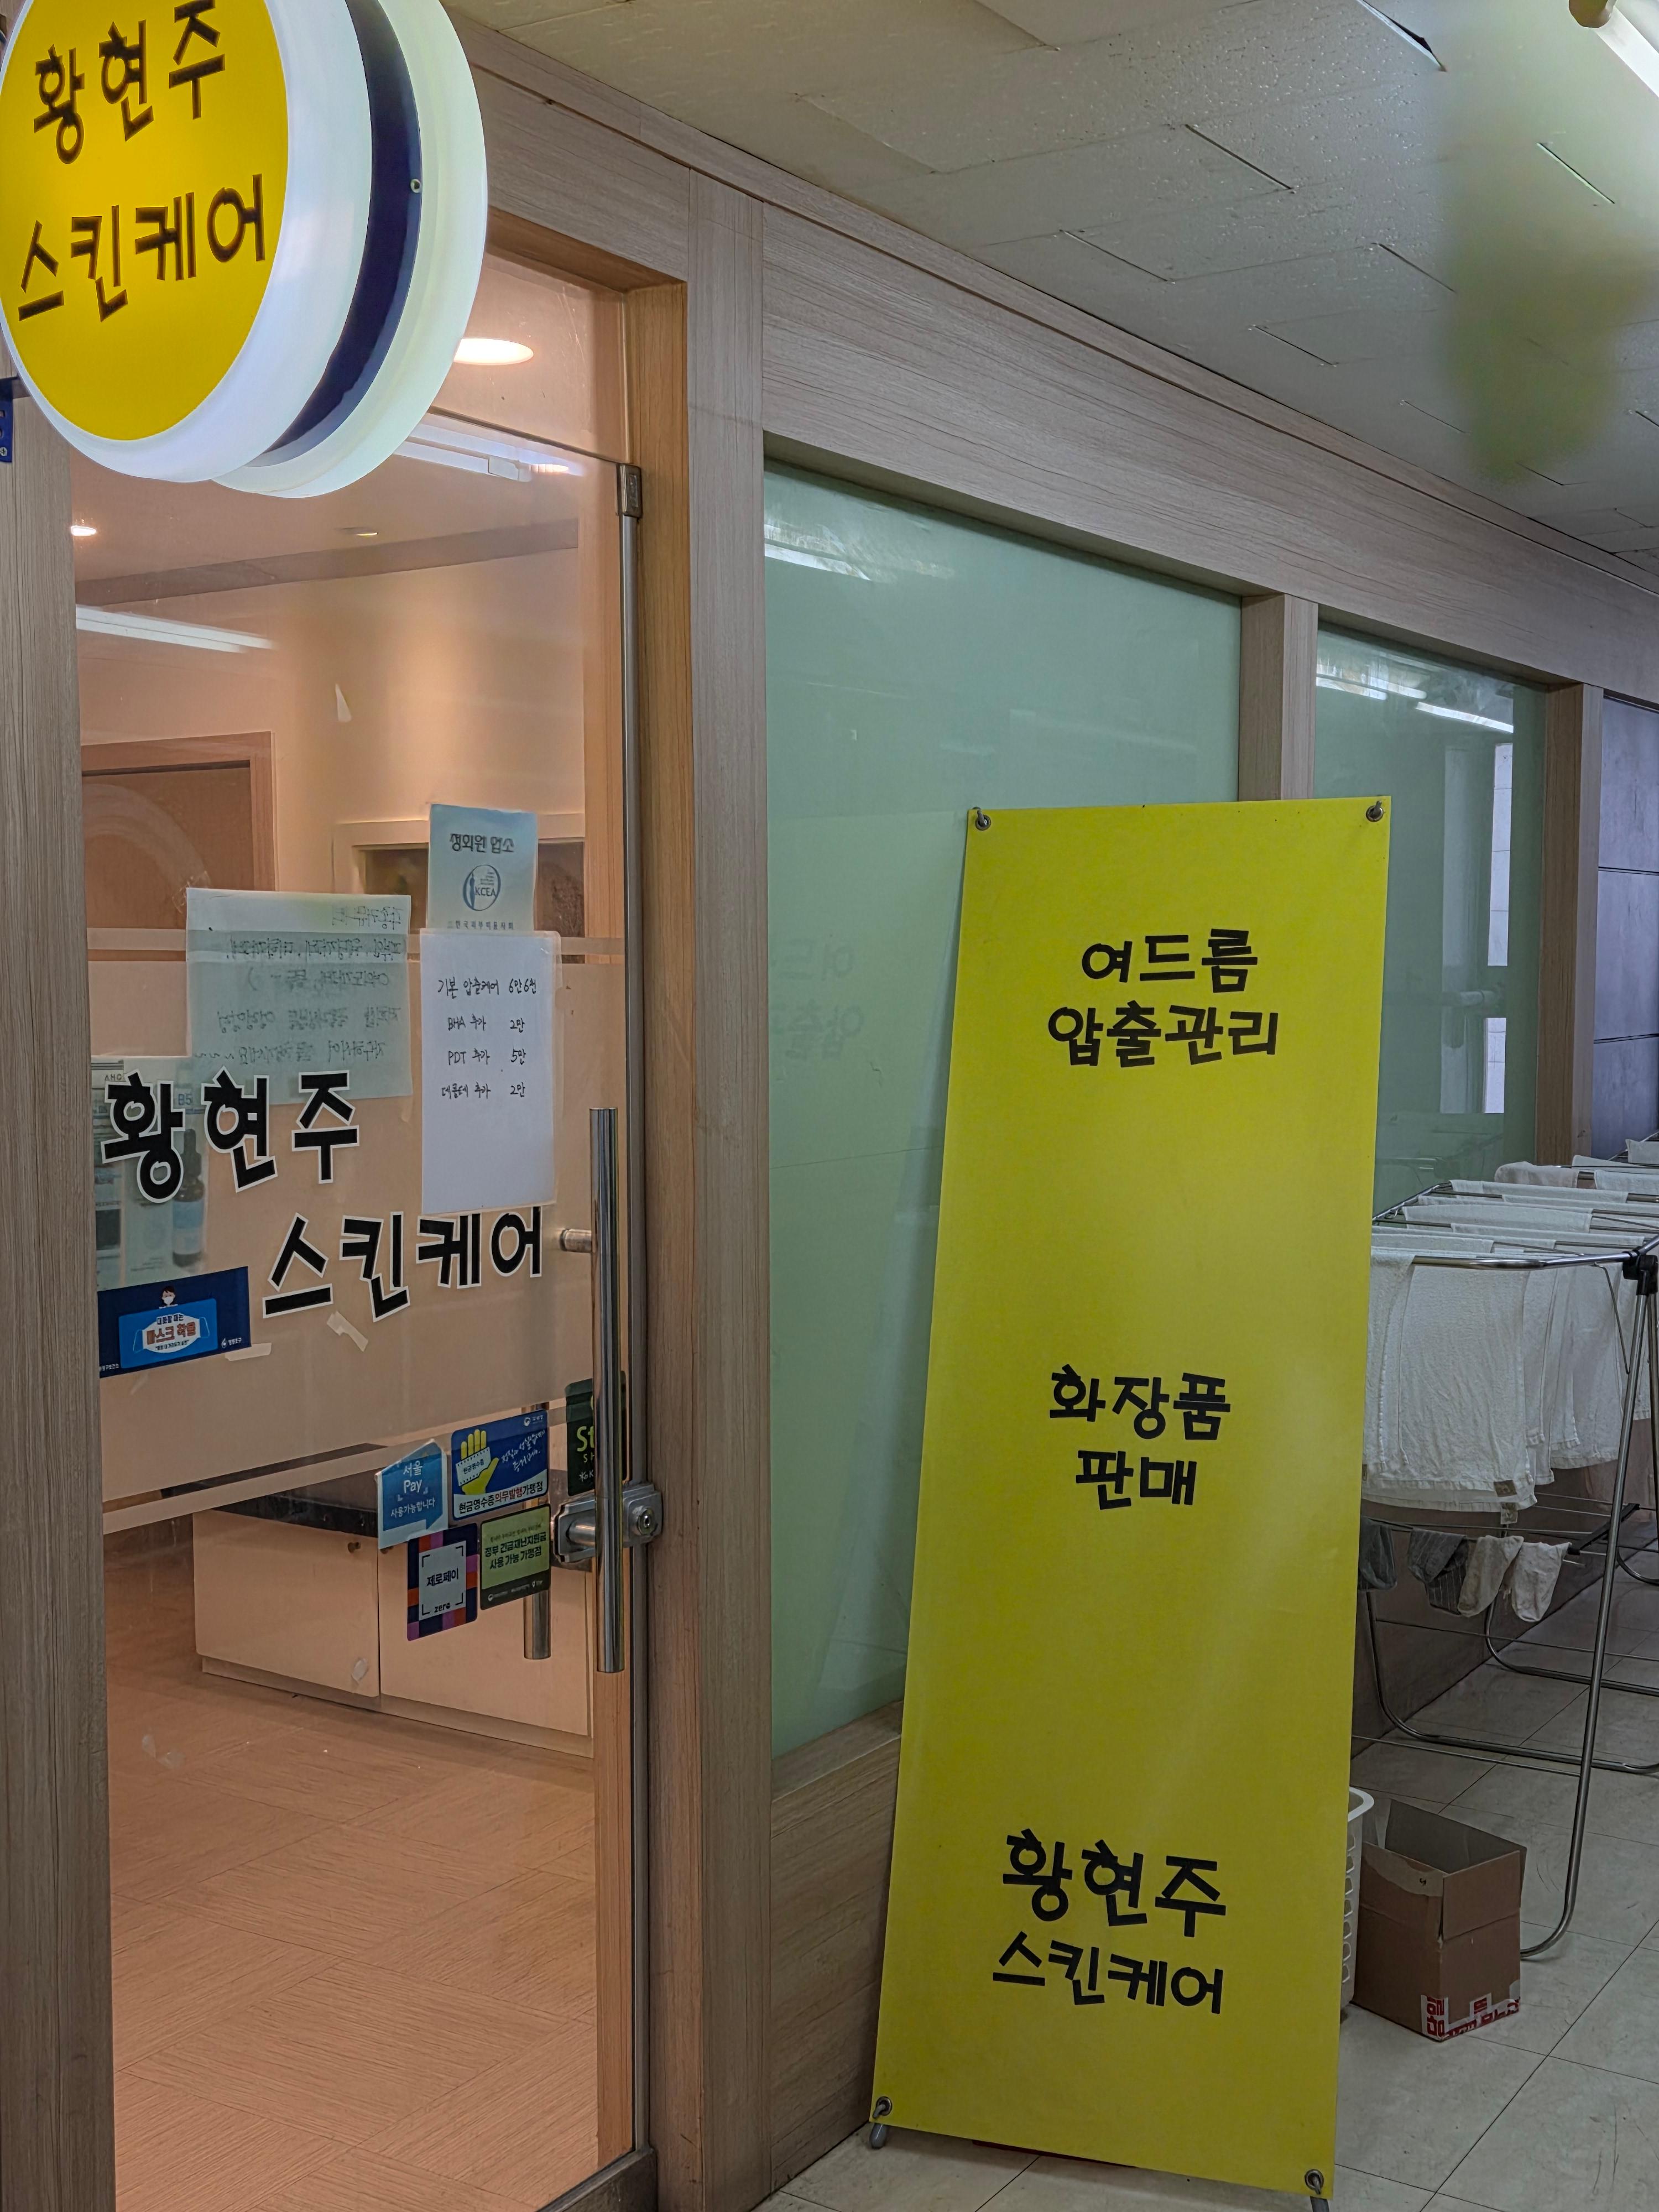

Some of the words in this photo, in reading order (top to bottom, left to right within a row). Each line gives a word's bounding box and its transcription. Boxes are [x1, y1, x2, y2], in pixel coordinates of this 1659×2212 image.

[34, 0, 226, 164] 황현주
[18, 174, 265, 322] 스킨케어
[450, 833, 488, 853] 정회원
[491, 836, 515, 854] 업소
[475, 887, 496, 897] KCEA
[1082, 928, 1258, 993] 여드름
[437, 977, 458, 999] 기본
[448, 1016, 466, 1031] BHA
[470, 1014, 487, 1031] 추가
[510, 1018, 525, 1033] 2만
[1048, 1000, 1278, 1068] 압출관리
[448, 1051, 466, 1065] PDT
[472, 1048, 491, 1066] 추가
[510, 1048, 526, 1065] 5만
[474, 1081, 491, 1099] 추가
[510, 1082, 525, 1098] 2만
[101, 1066, 359, 1203] 황현주
[262, 1206, 542, 1322] 스킨케어
[147, 1326, 175, 1345] 마스크
[1050, 1364, 1231, 1441] 화장품
[403, 1460, 423, 1478] 서울
[1076, 1451, 1197, 1510] 판매
[404, 1479, 422, 1494] Pay
[390, 1497, 436, 1519] 사용가능합니다
[484, 1545, 499, 1558] 정부
[500, 1531, 546, 1553] 긴급재난지원금
[490, 1556, 504, 1570] 사용
[505, 1552, 520, 1566] 가능
[520, 1547, 541, 1561] 가맹점
[426, 1567, 458, 1587] 제로페이
[1003, 1828, 1226, 1938] 황현주
[993, 1931, 1223, 2015] 스킨케어
